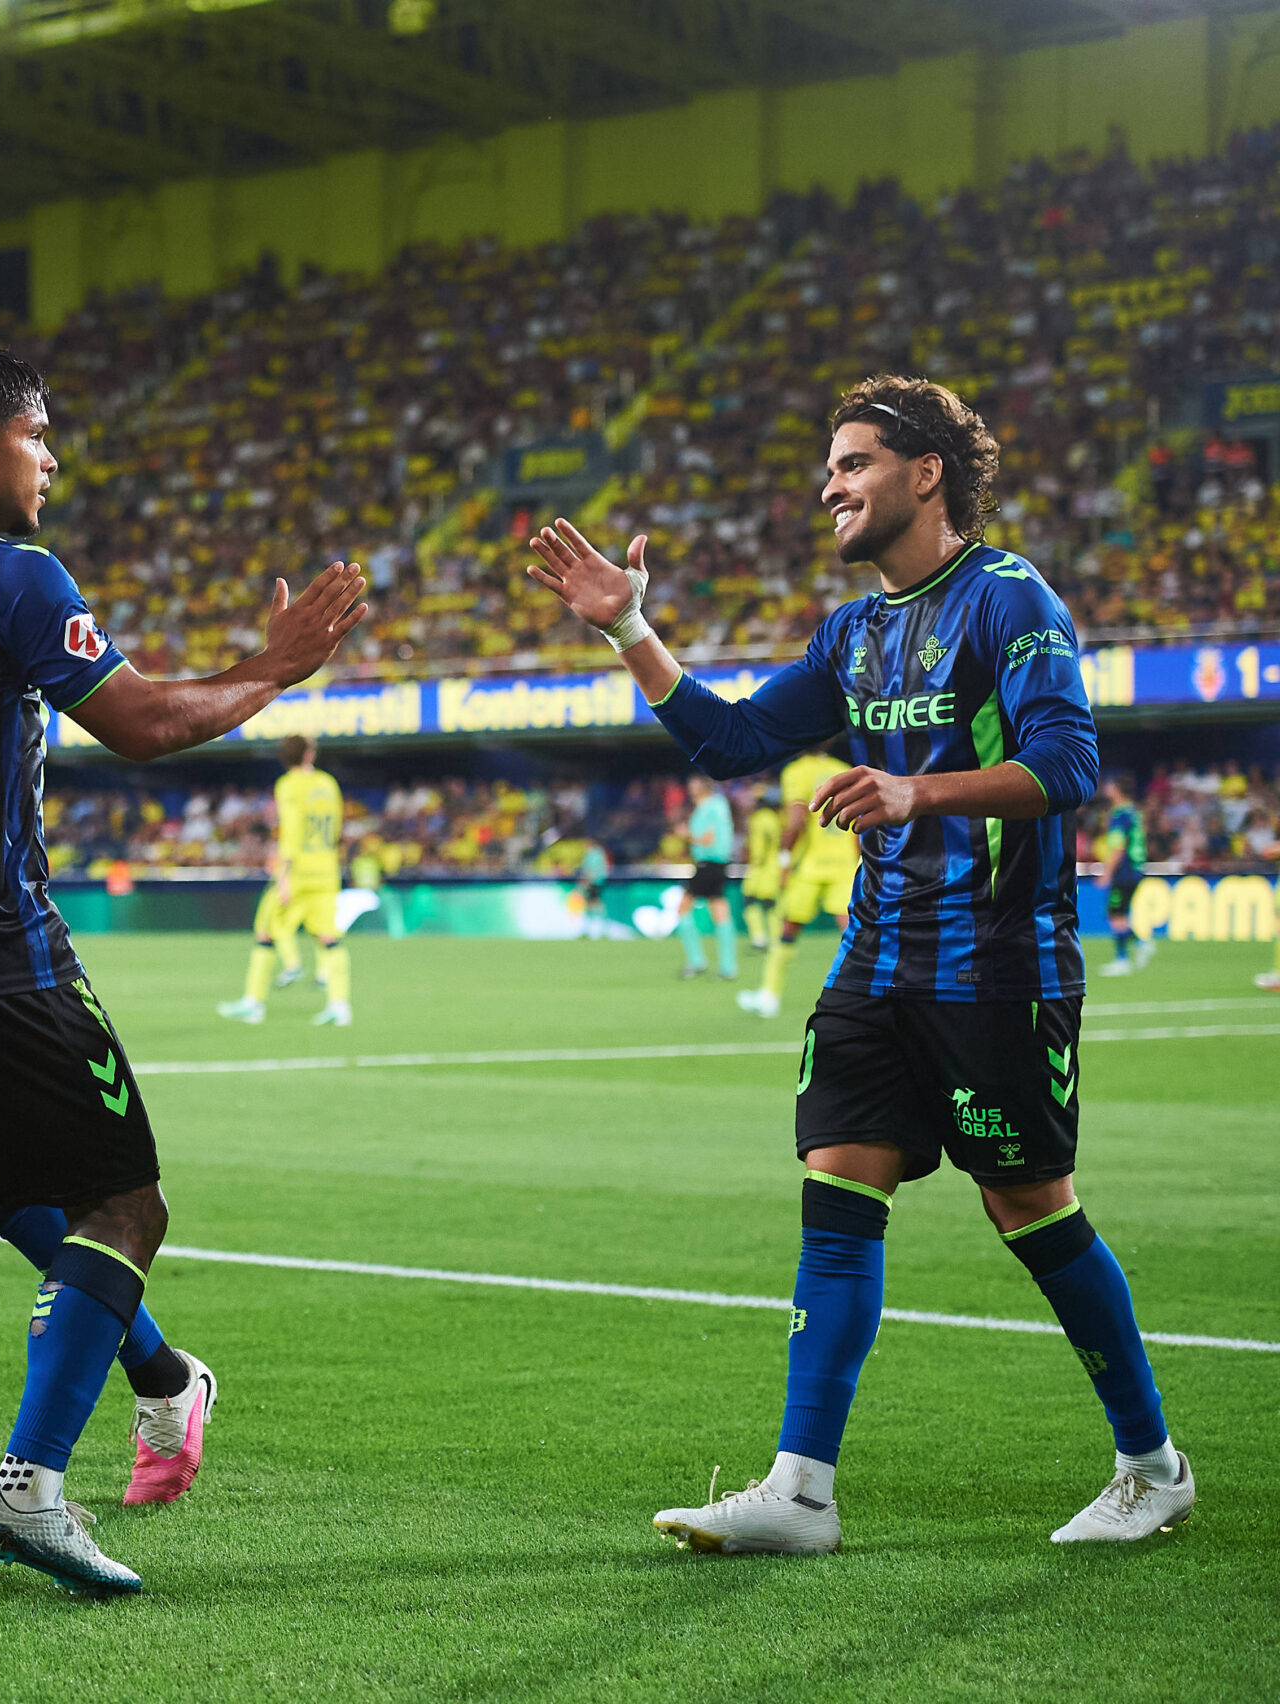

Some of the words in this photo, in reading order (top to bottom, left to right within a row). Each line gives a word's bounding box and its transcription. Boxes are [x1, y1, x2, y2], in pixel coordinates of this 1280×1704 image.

[1004, 629, 1070, 659] REVEL
[1040, 646, 1051, 655] DE
[864, 693, 956, 731] GREE
[962, 1106, 1002, 1123] AUS
